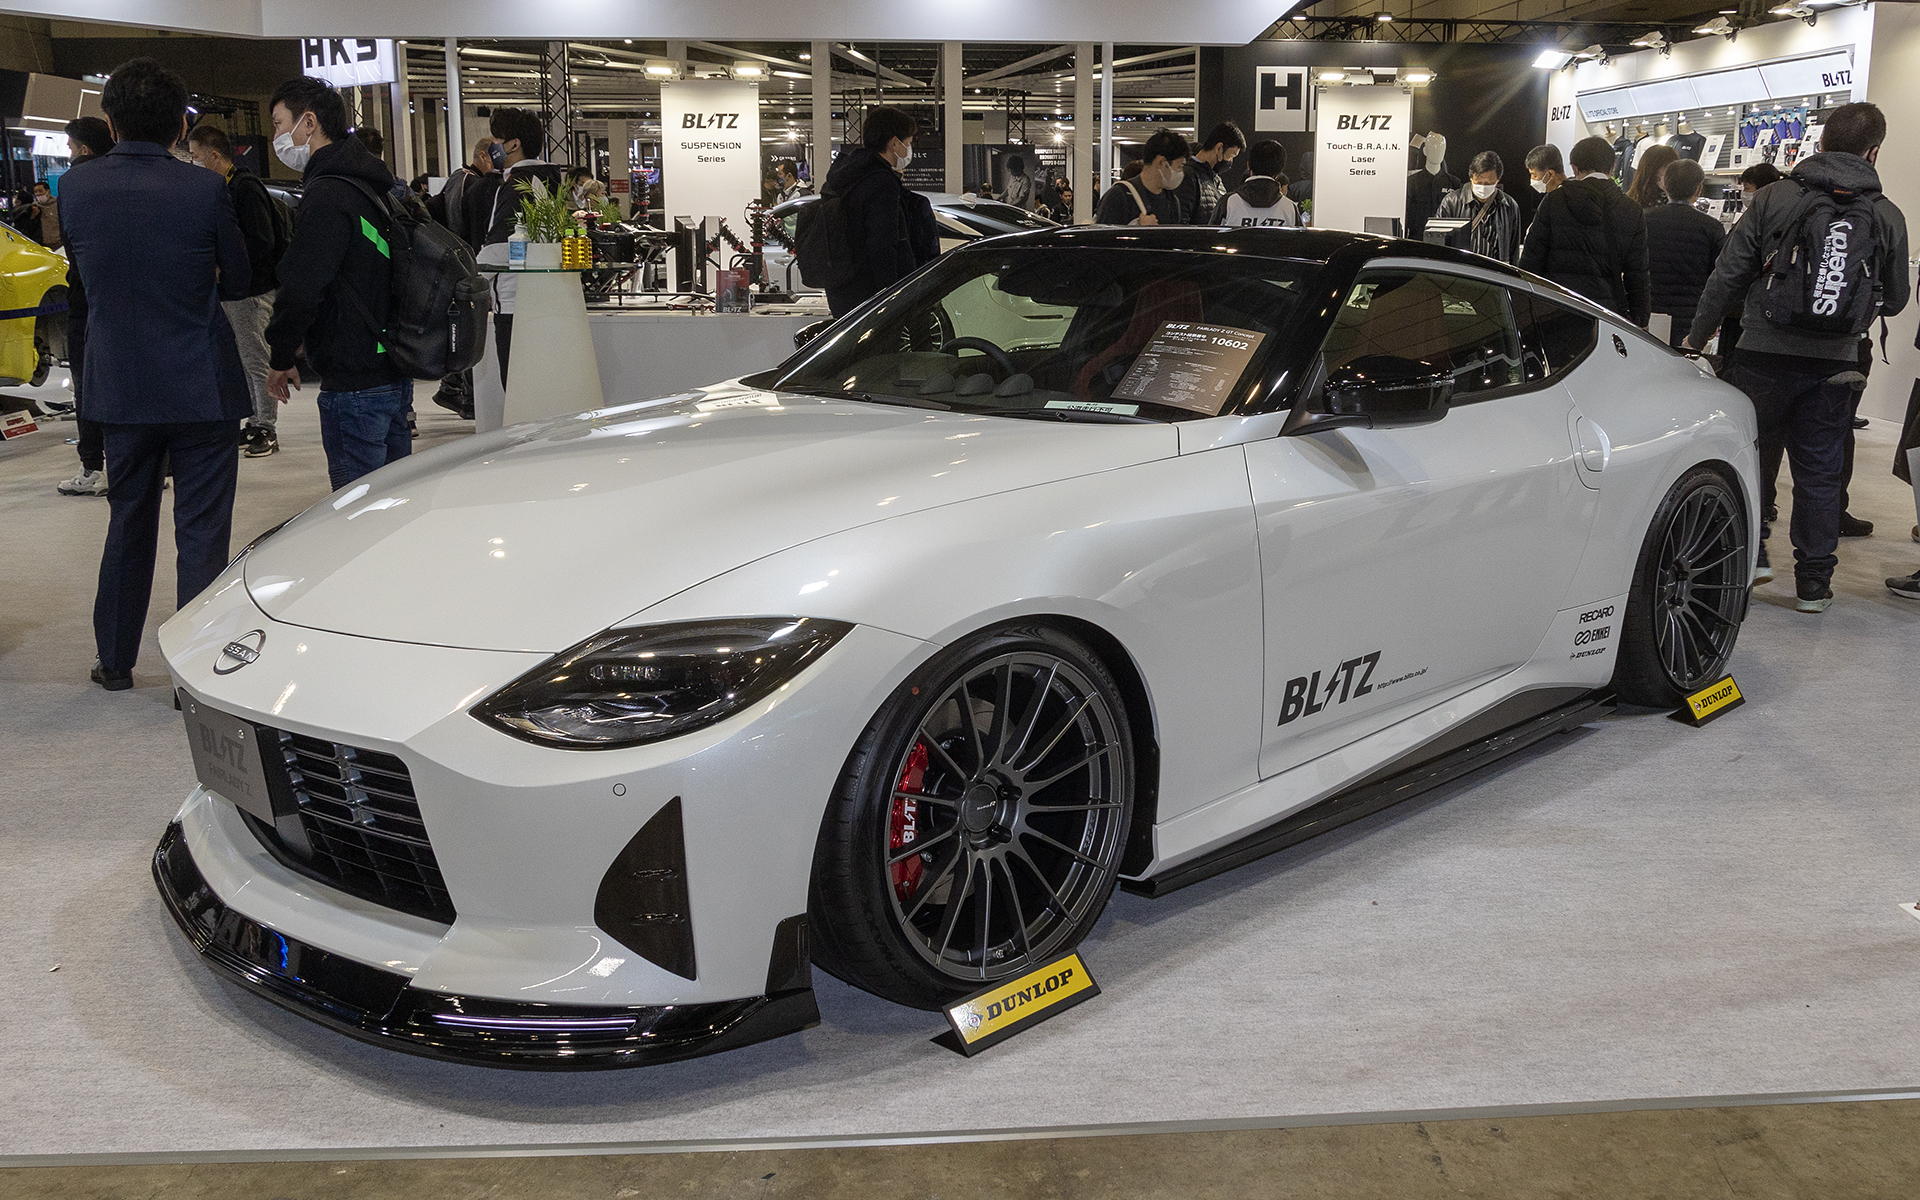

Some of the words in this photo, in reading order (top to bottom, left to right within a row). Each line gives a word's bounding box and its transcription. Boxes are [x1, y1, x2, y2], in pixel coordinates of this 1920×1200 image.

[305, 39, 377, 68] HKS
[1822, 70, 1852, 87] BLITZ
[682, 112, 739, 129] BLITZ
[1551, 105, 1571, 121] BLITZ
[1336, 114, 1393, 131] BLITZ
[1327, 142, 1401, 151] Touch-B.R.A.I.N.
[697, 155, 726, 163] Series
[1351, 155, 1376, 164] Laser
[1349, 168, 1377, 176] Series
[1241, 217, 1286, 227] BLITZ
[1812, 219, 1853, 316] Superdry
[1211, 337, 1249, 350] 10602
[1579, 605, 1615, 624] RECARO
[224, 644, 253, 661] SSAN
[1575, 647, 1606, 659] DUNLOP
[1277, 650, 1382, 727] BLITZ
[1701, 685, 1733, 708] DUNLOP
[199, 722, 248, 774] BLITZ
[986, 968, 1074, 1021] DUNLOP
